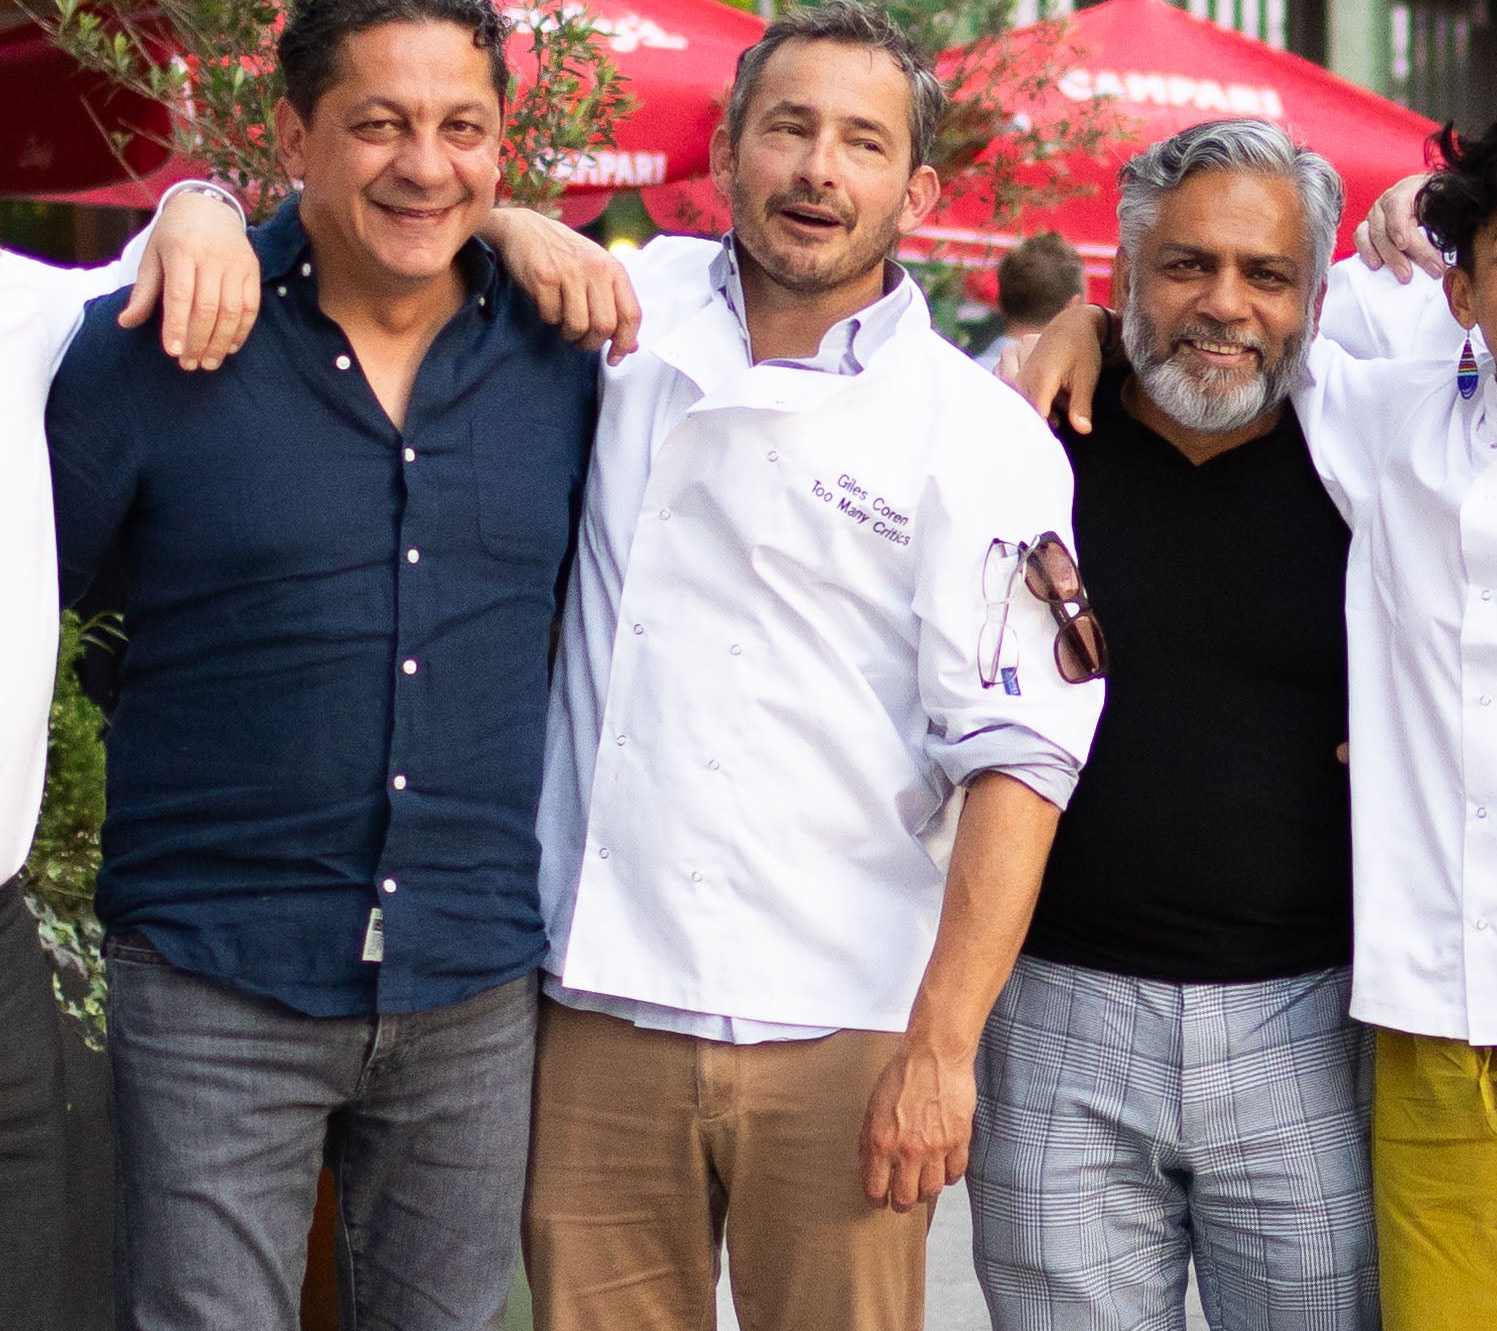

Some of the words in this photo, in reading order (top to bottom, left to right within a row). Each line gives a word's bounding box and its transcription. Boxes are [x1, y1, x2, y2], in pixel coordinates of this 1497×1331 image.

[1058, 69, 1282, 118] CAMPARI
[811, 478, 834, 503] Too
[836, 496, 871, 525] Many
[872, 521, 911, 546] Critics
[837, 473, 868, 501] Giles
[872, 497, 909, 527] Coren
